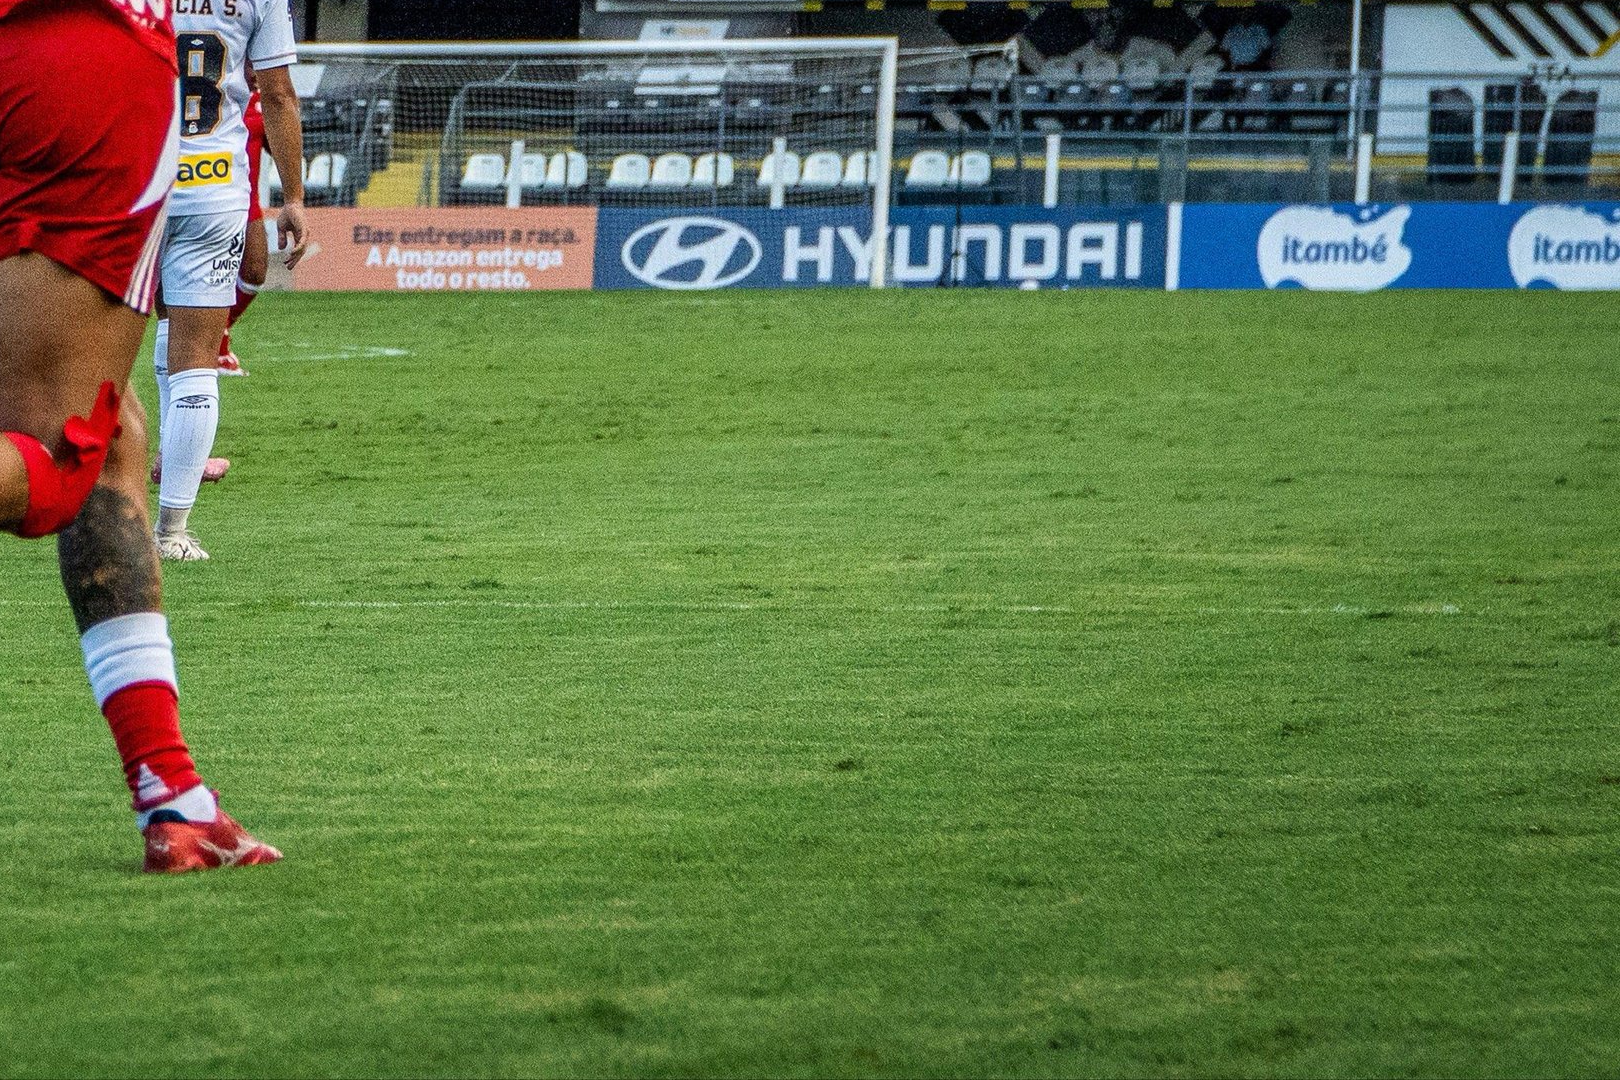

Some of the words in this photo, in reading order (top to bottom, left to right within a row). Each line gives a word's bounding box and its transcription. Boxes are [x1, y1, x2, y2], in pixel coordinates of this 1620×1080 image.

[353, 224, 394, 244] Elas
[400, 225, 505, 248] entregam
[1282, 233, 1388, 264] itambé
[1534, 233, 1620, 264] itamb
[366, 247, 381, 266] A
[385, 245, 472, 266] Amazon
[476, 247, 563, 270] entrega
[782, 222, 1143, 282] HYUNDAI
[396, 269, 445, 288] todo
[449, 273, 463, 288] o
[466, 270, 529, 288] resto.
